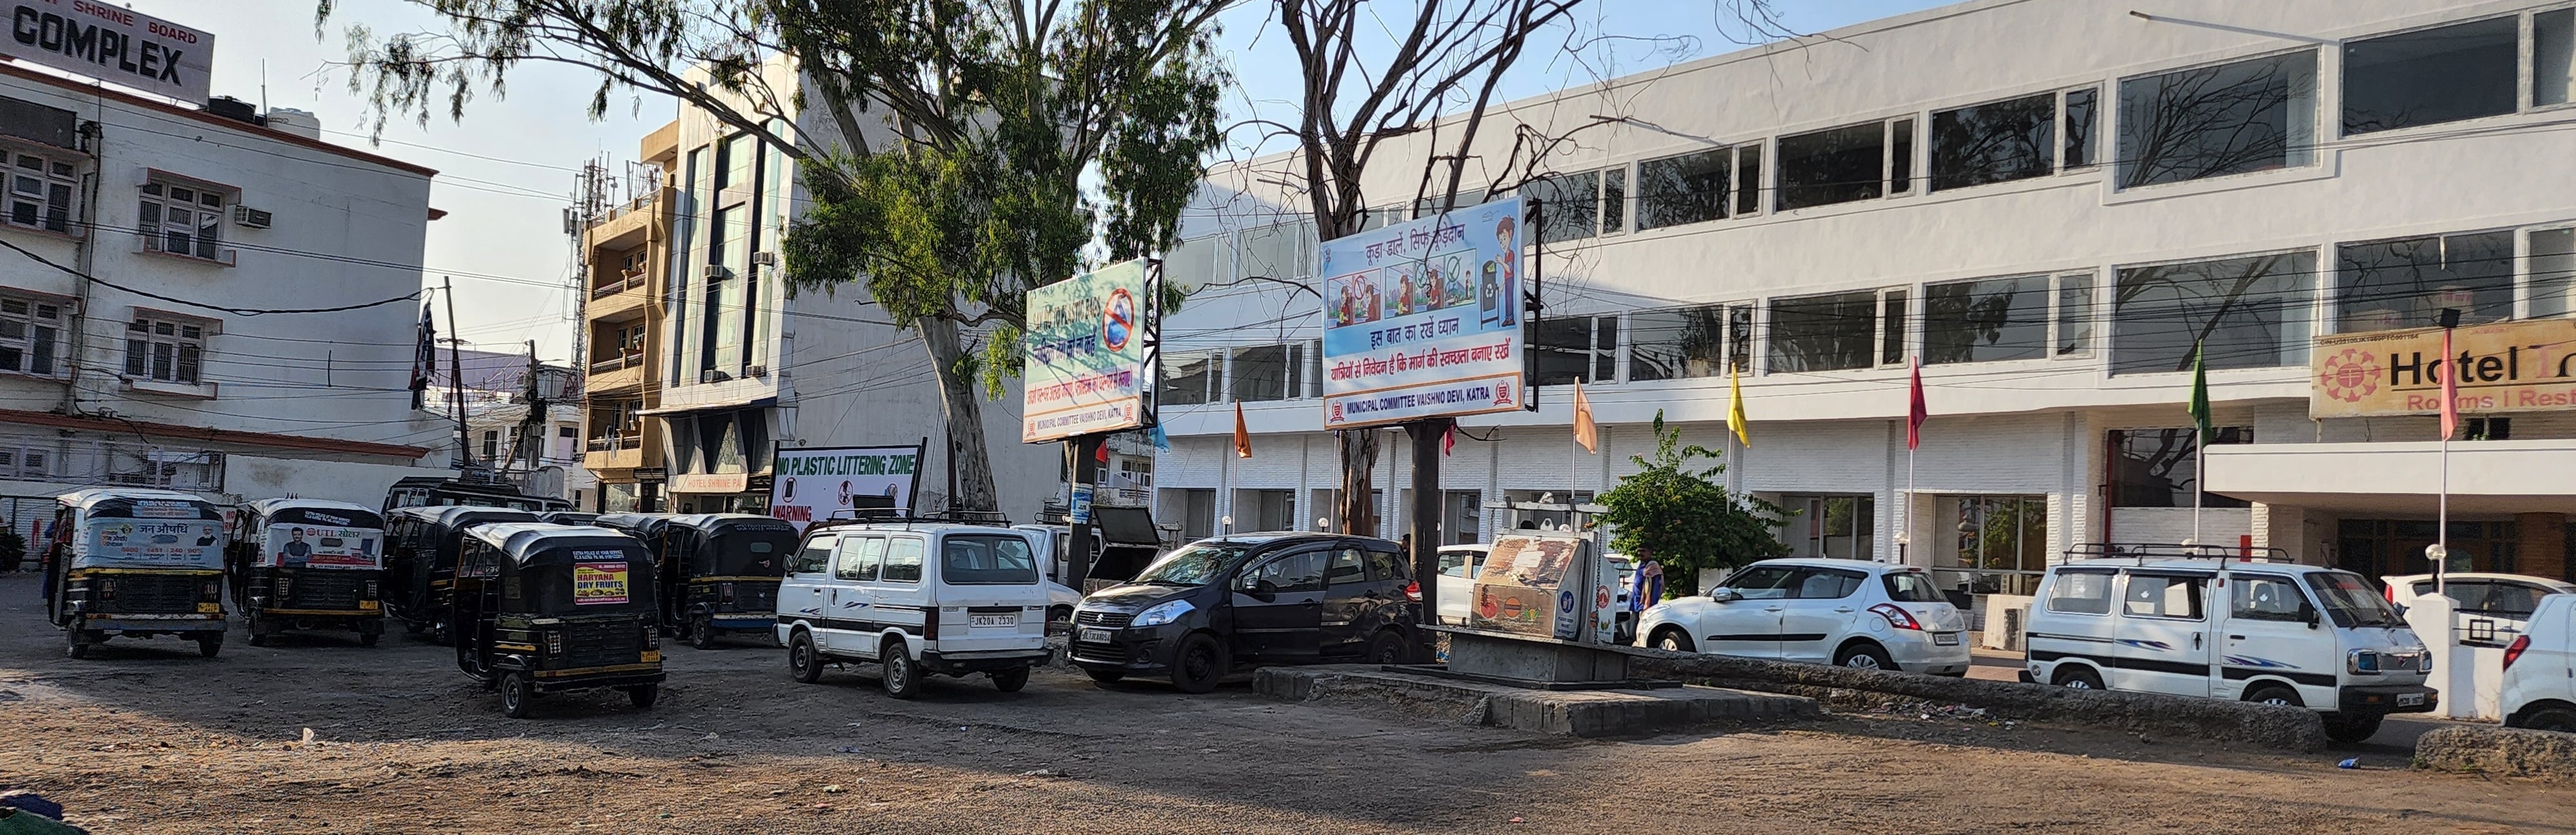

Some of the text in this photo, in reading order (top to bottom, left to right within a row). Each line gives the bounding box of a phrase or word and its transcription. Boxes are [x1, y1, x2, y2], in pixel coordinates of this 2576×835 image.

[73, 1, 198, 45] SHRINE BOARD
[12, 4, 184, 86] COMPLEX
[1365, 243, 1384, 266] कूड़ा
[1409, 226, 1430, 252] सिर्फ
[1033, 311, 1043, 331] SAY
[1053, 306, 1060, 327] TO
[1061, 300, 1085, 325] PLASTIC
[1085, 296, 1101, 320] BAGS
[1067, 332, 1076, 359] को
[1076, 337, 1083, 357] ना
[1085, 325, 1097, 357] कहें
[1370, 316, 1459, 350] इस बात का रखें ध्यान
[1331, 337, 1511, 381] यात्रियों से निवेदन है कि मार्ग की स्वच्छता बनाए रखें
[1347, 399, 1378, 414] MUNICIPAL
[1380, 394, 1415, 410] COMMITTEE
[1416, 391, 1445, 407] VAISHNO
[1466, 386, 1490, 401] KATRA
[2407, 393, 2493, 410] Roms
[1038, 417, 1056, 430] MUNICIPAL
[1057, 414, 1079, 428] COMMITTEE
[1079, 410, 1096, 425] VAISHNO
[1108, 407, 1121, 420] KATRA
[777, 454, 915, 476] NO PLASTIC LITTERING ZONE
[688, 479, 706, 488] HOTEL
[139, 522, 188, 534] जन औषधि
[773, 505, 812, 523] WARNING
